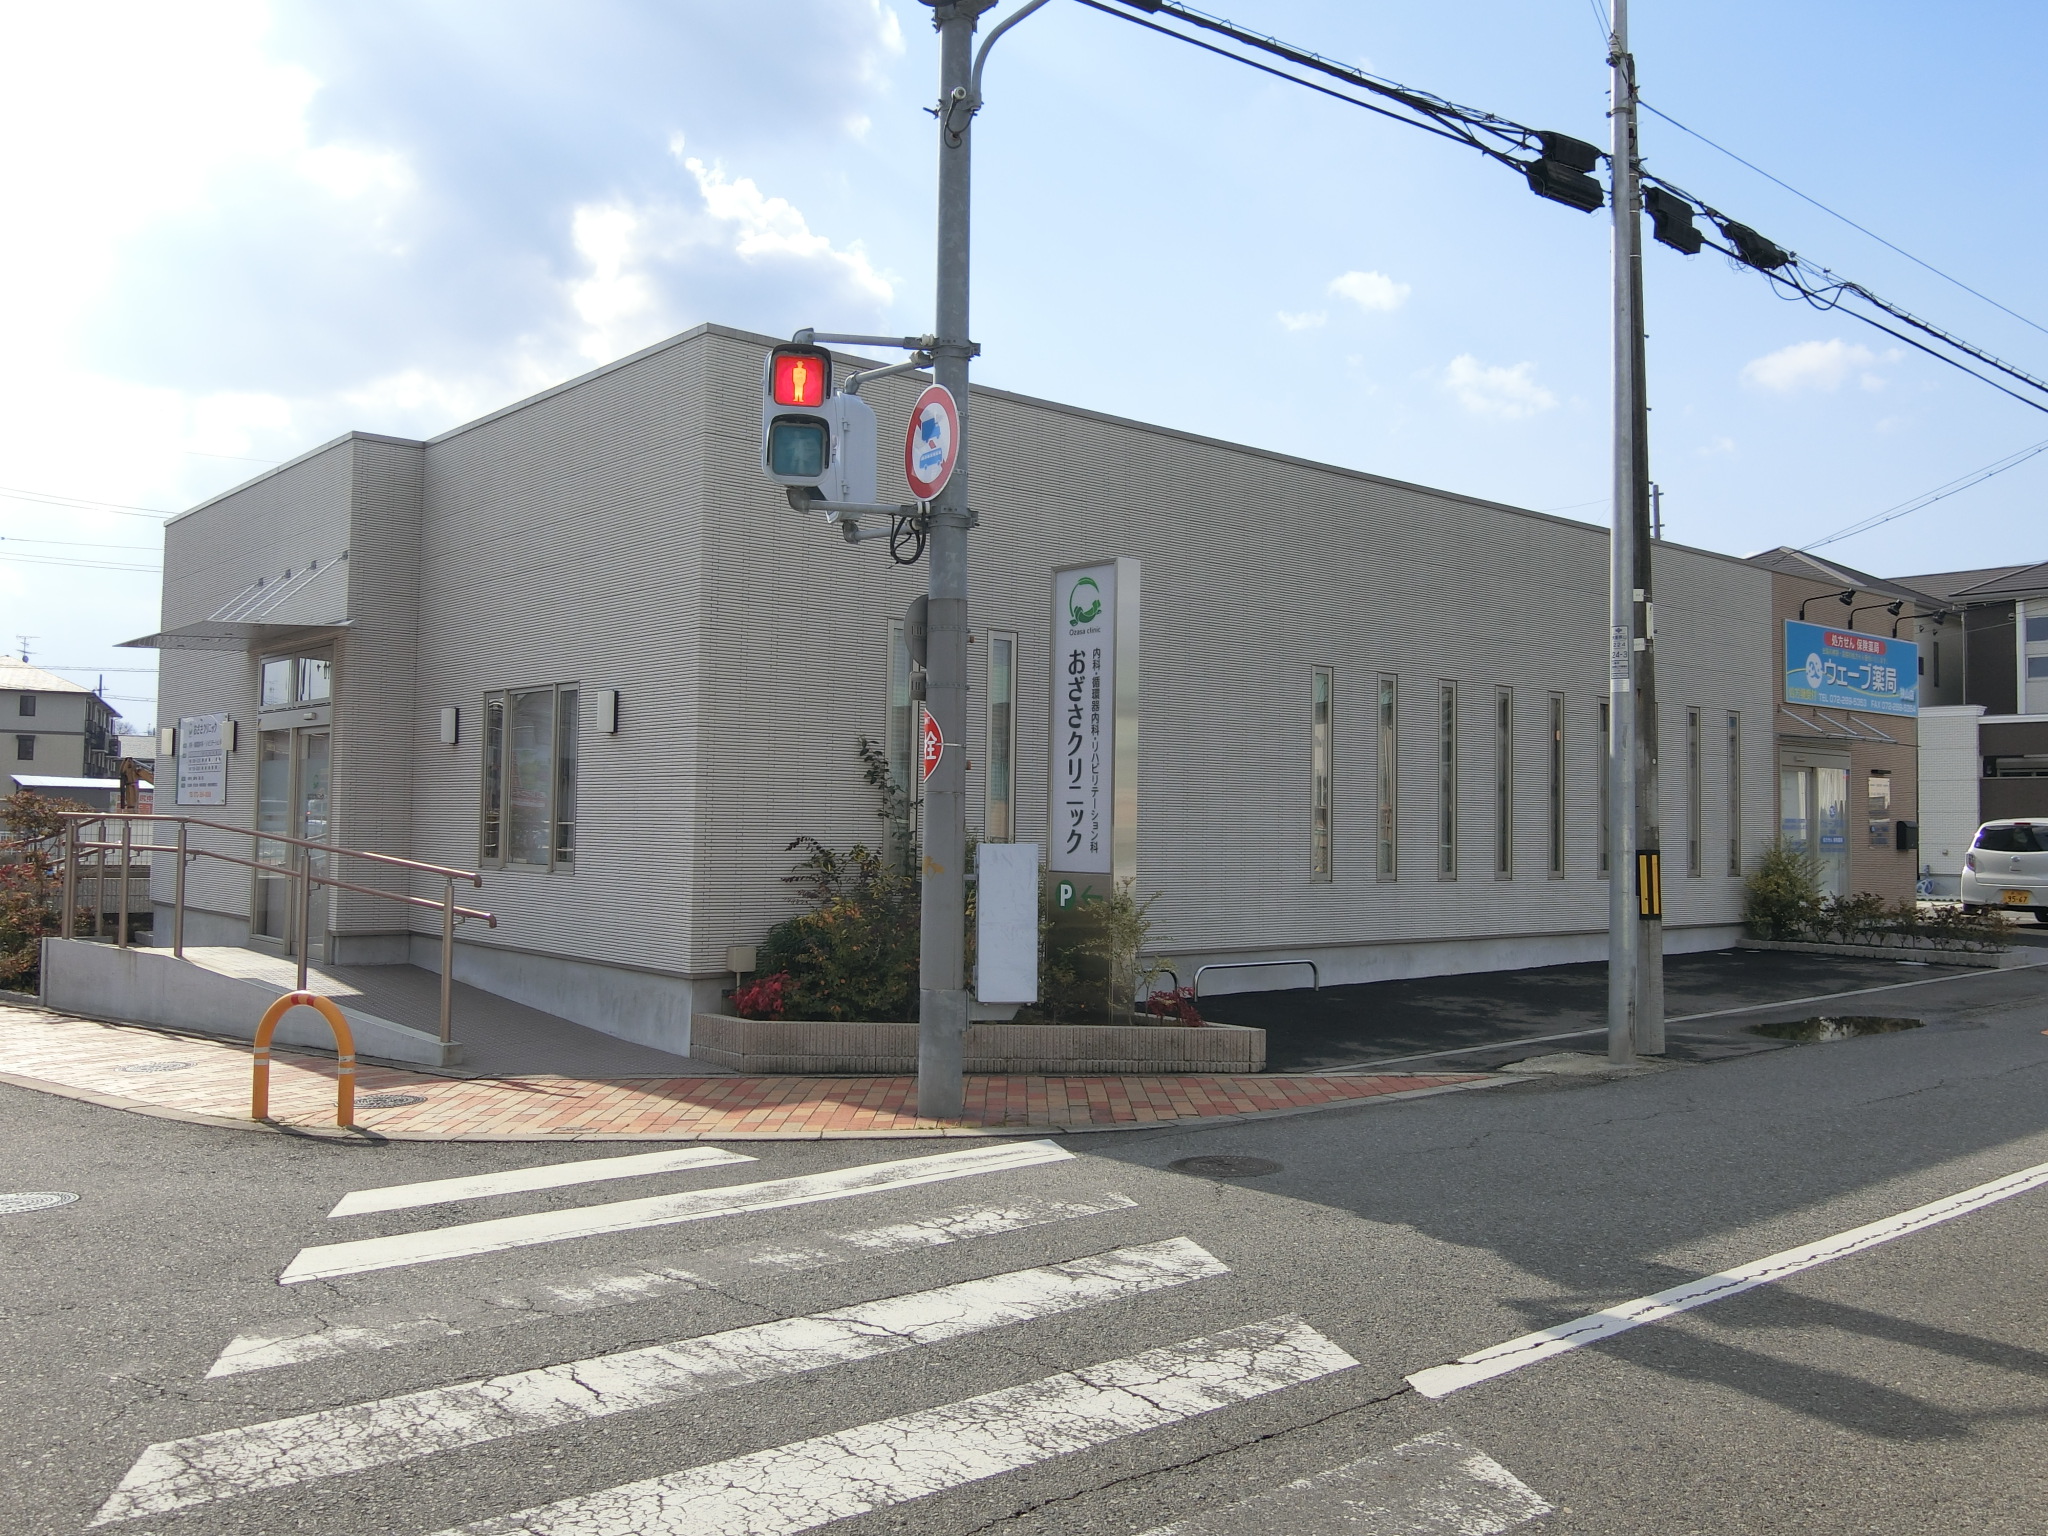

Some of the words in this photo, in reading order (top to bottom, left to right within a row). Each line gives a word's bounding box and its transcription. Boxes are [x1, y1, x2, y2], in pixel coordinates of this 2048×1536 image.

[1069, 628, 1086, 636] Ozasa
[1087, 626, 1101, 634] clinic
[1831, 634, 1855, 649] 処方せん
[1857, 639, 1880, 654] 保険薬局
[1819, 693, 1829, 703] TEL
[1871, 700, 1881, 709] FAX
[1066, 649, 1086, 855] おざさクリニック
[1090, 647, 1101, 853] 内科・循環器内科・リハビリテーション科
[1059, 884, 1072, 907] P
